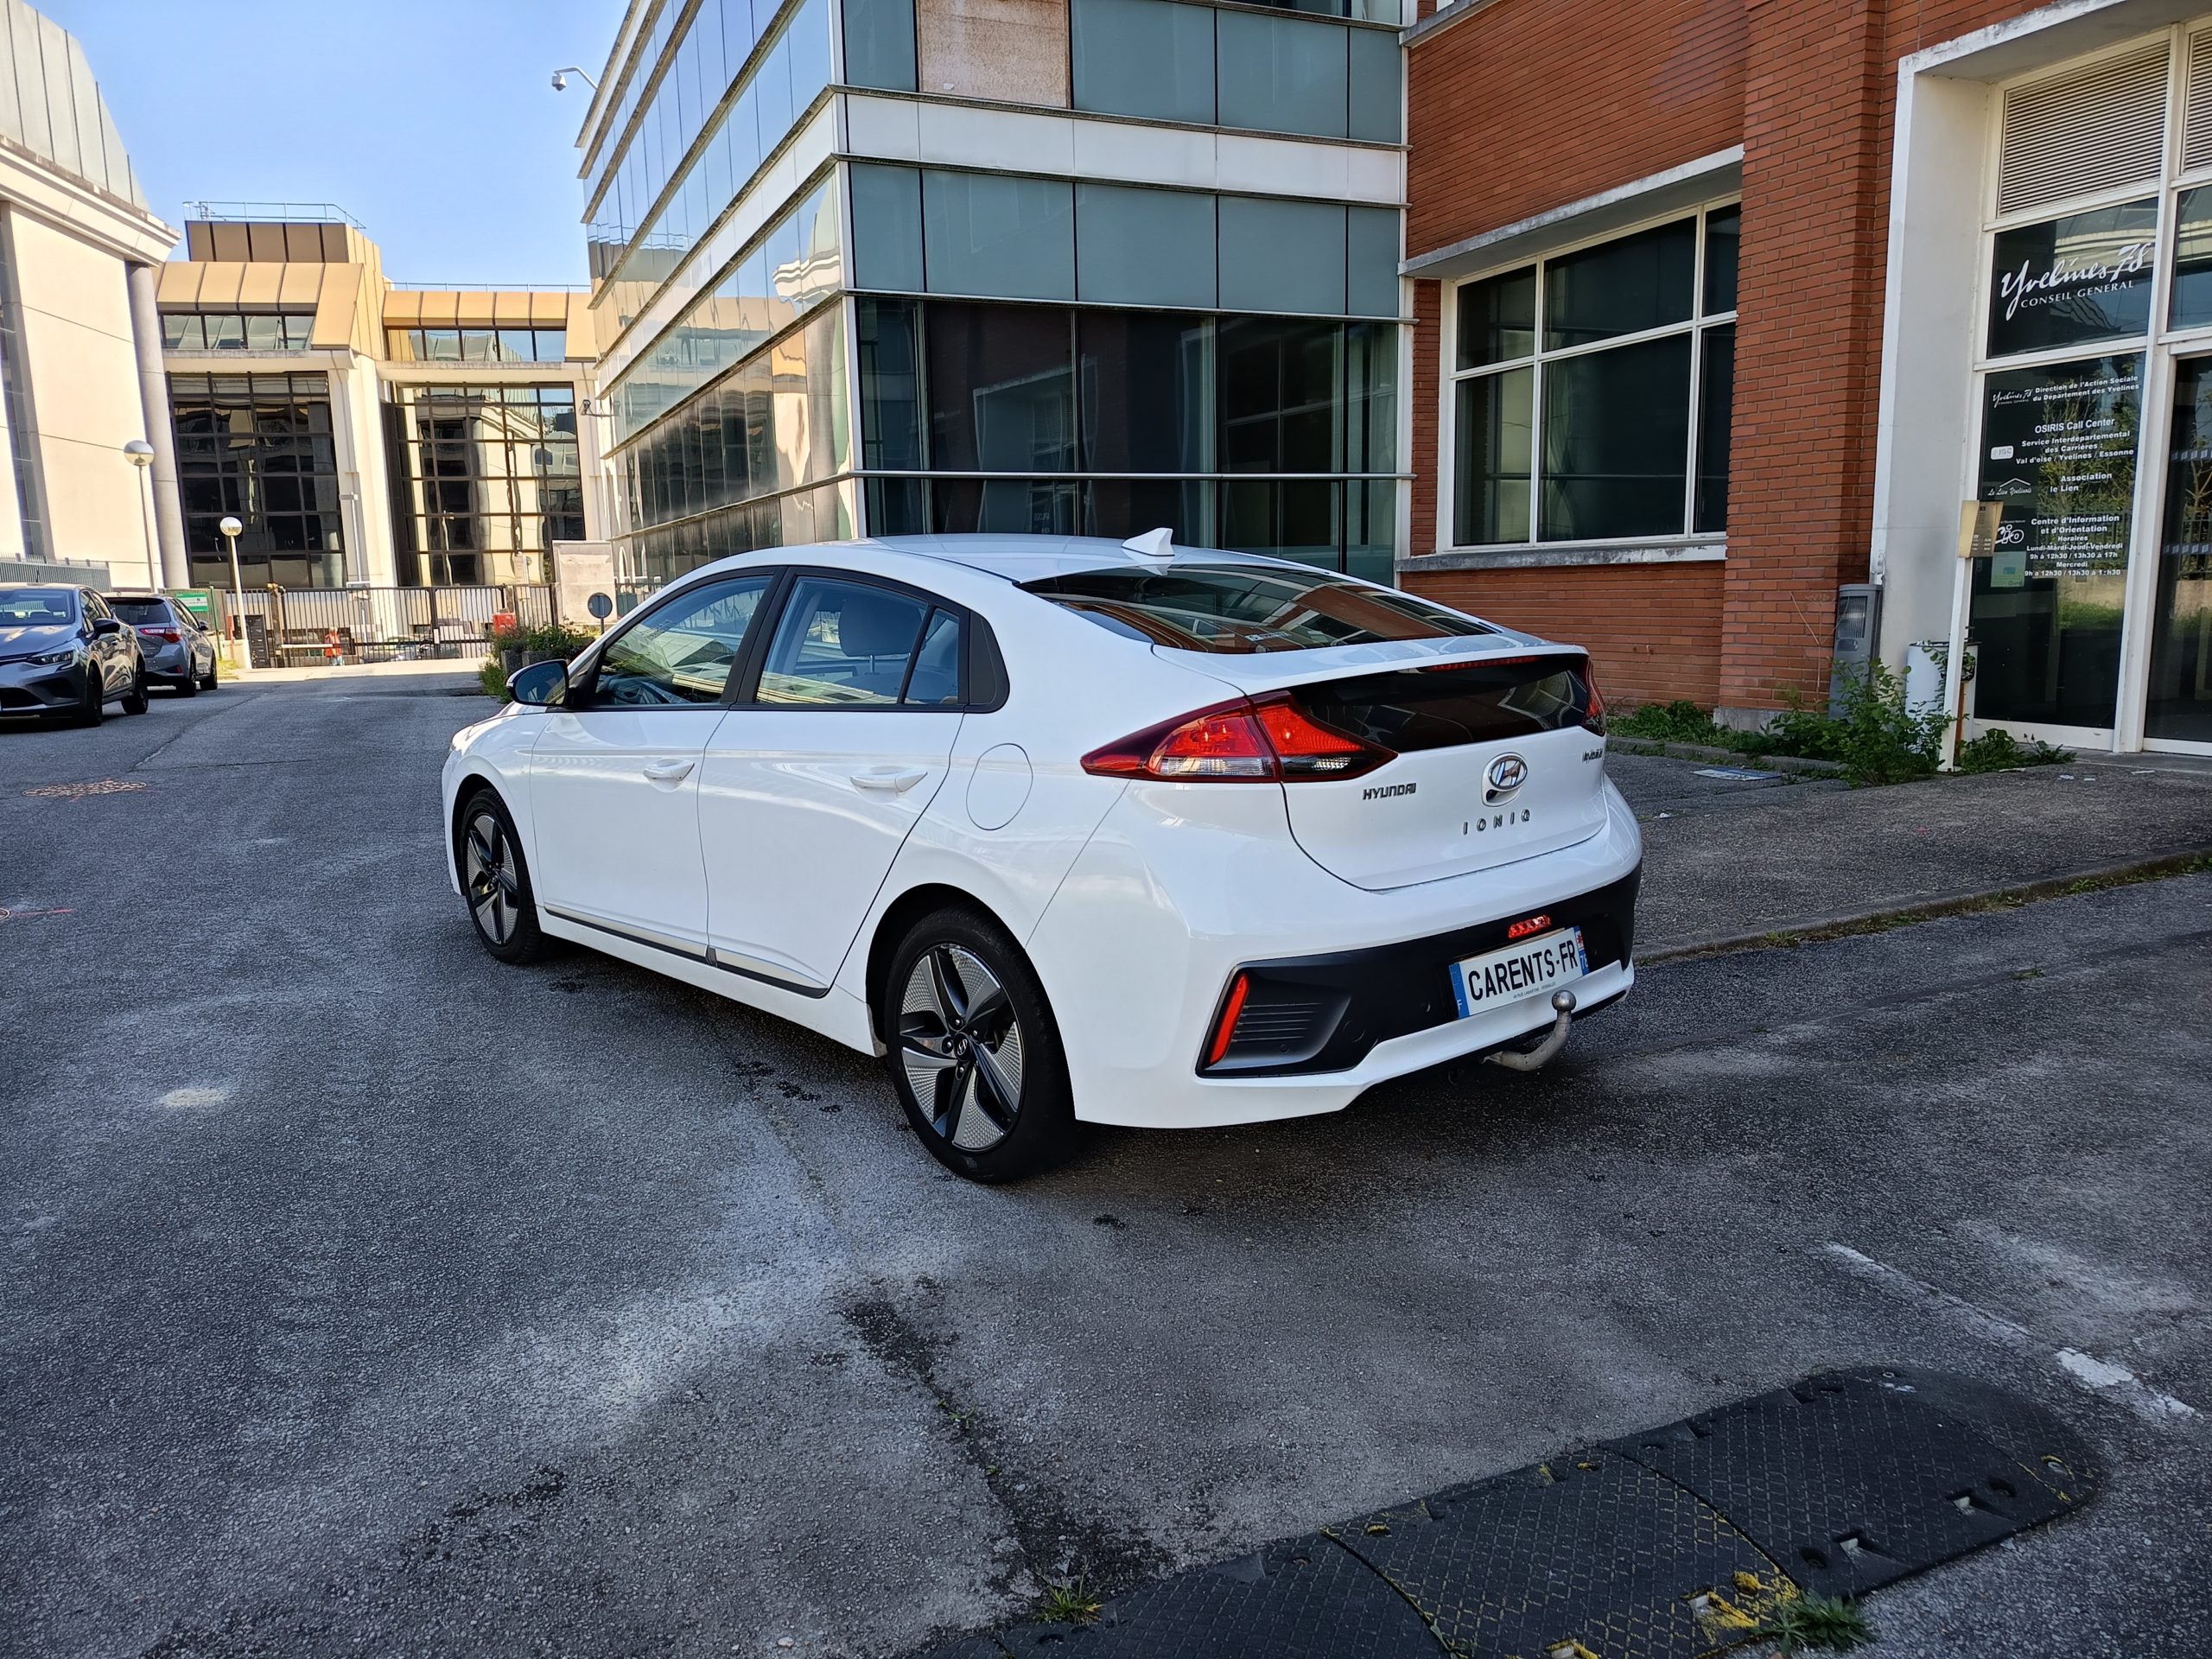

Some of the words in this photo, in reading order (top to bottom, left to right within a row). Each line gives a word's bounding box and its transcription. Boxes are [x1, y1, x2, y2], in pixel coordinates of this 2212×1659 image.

[2000, 257, 2108, 321] Yvelines
[2110, 242, 2152, 283] 78
[2020, 292, 2072, 308] CONSEIL
[2076, 280, 2134, 298] GENERAL
[2035, 385, 2068, 393] Direction
[2080, 379, 2108, 388] l'Action
[2109, 375, 2139, 385] Sociale
[2107, 384, 2139, 393] Yvelines
[2034, 422, 2064, 434] OSIRIS
[2066, 420, 2083, 430] Call
[2085, 418, 2115, 429] Center
[2021, 438, 2050, 448] Service
[2099, 449, 2134, 458] Essonne
[2060, 472, 2113, 482] Association
[2061, 514, 2120, 524] d'Information
[2050, 524, 2107, 534] d'Orientation
[1362, 782, 1417, 800] HYUNDAI
[1463, 809, 1530, 835] IONIQ
[1468, 939, 1579, 1001] CARENTS-FR
[1456, 998, 1463, 1011] F
